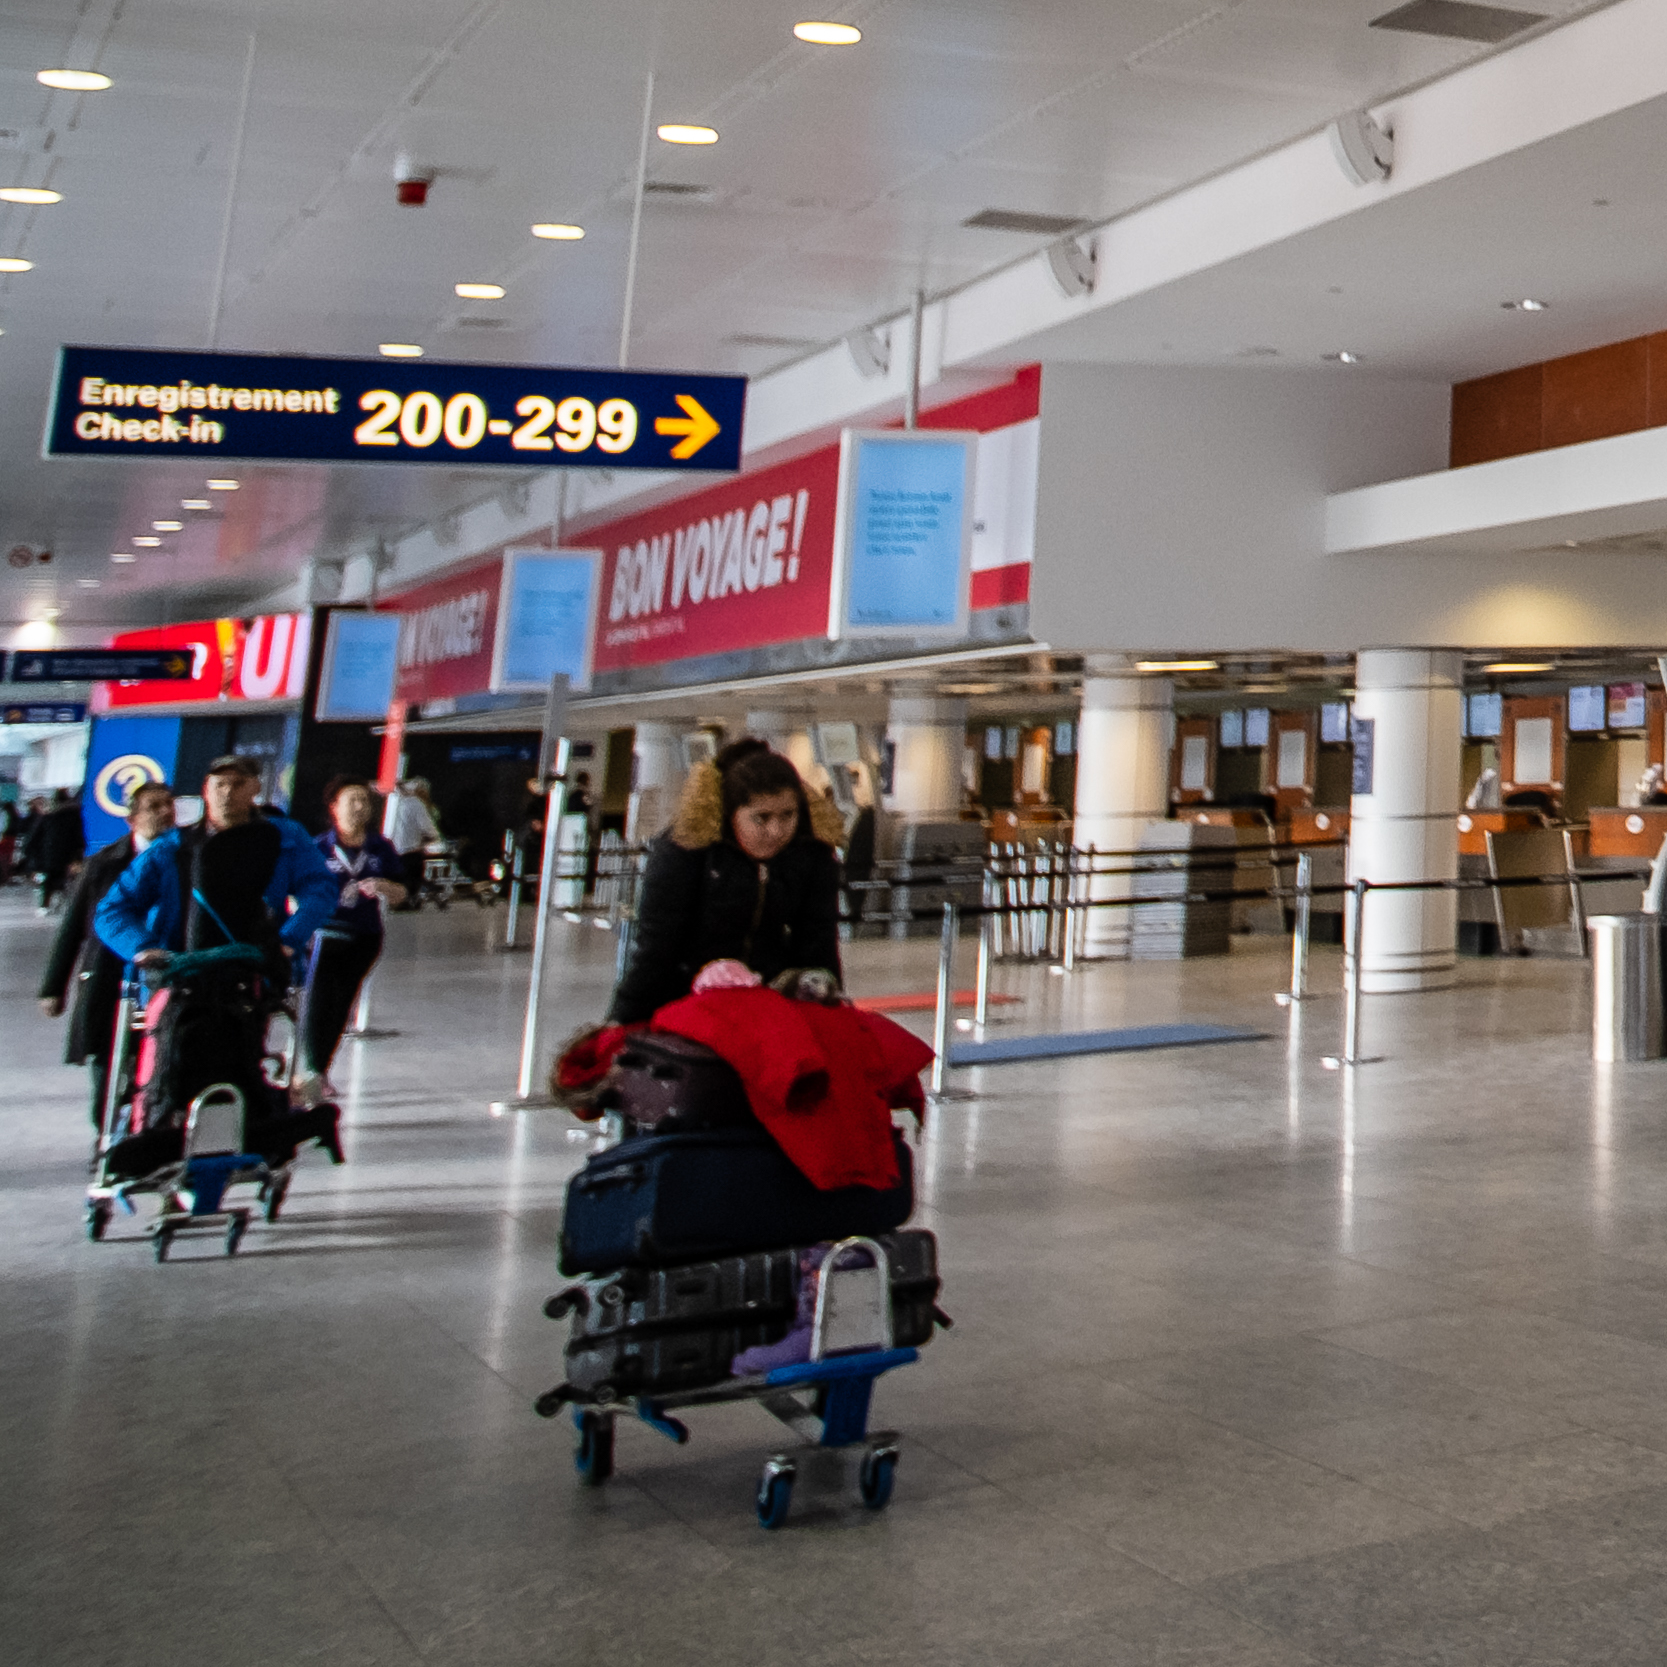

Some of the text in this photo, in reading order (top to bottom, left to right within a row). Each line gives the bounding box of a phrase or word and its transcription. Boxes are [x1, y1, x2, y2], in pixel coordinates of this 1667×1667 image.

[80, 378, 340, 414] Enregistrement
[75, 412, 223, 444] Check-in
[355, 390, 638, 452] 200-299
[608, 533, 671, 622] BON
